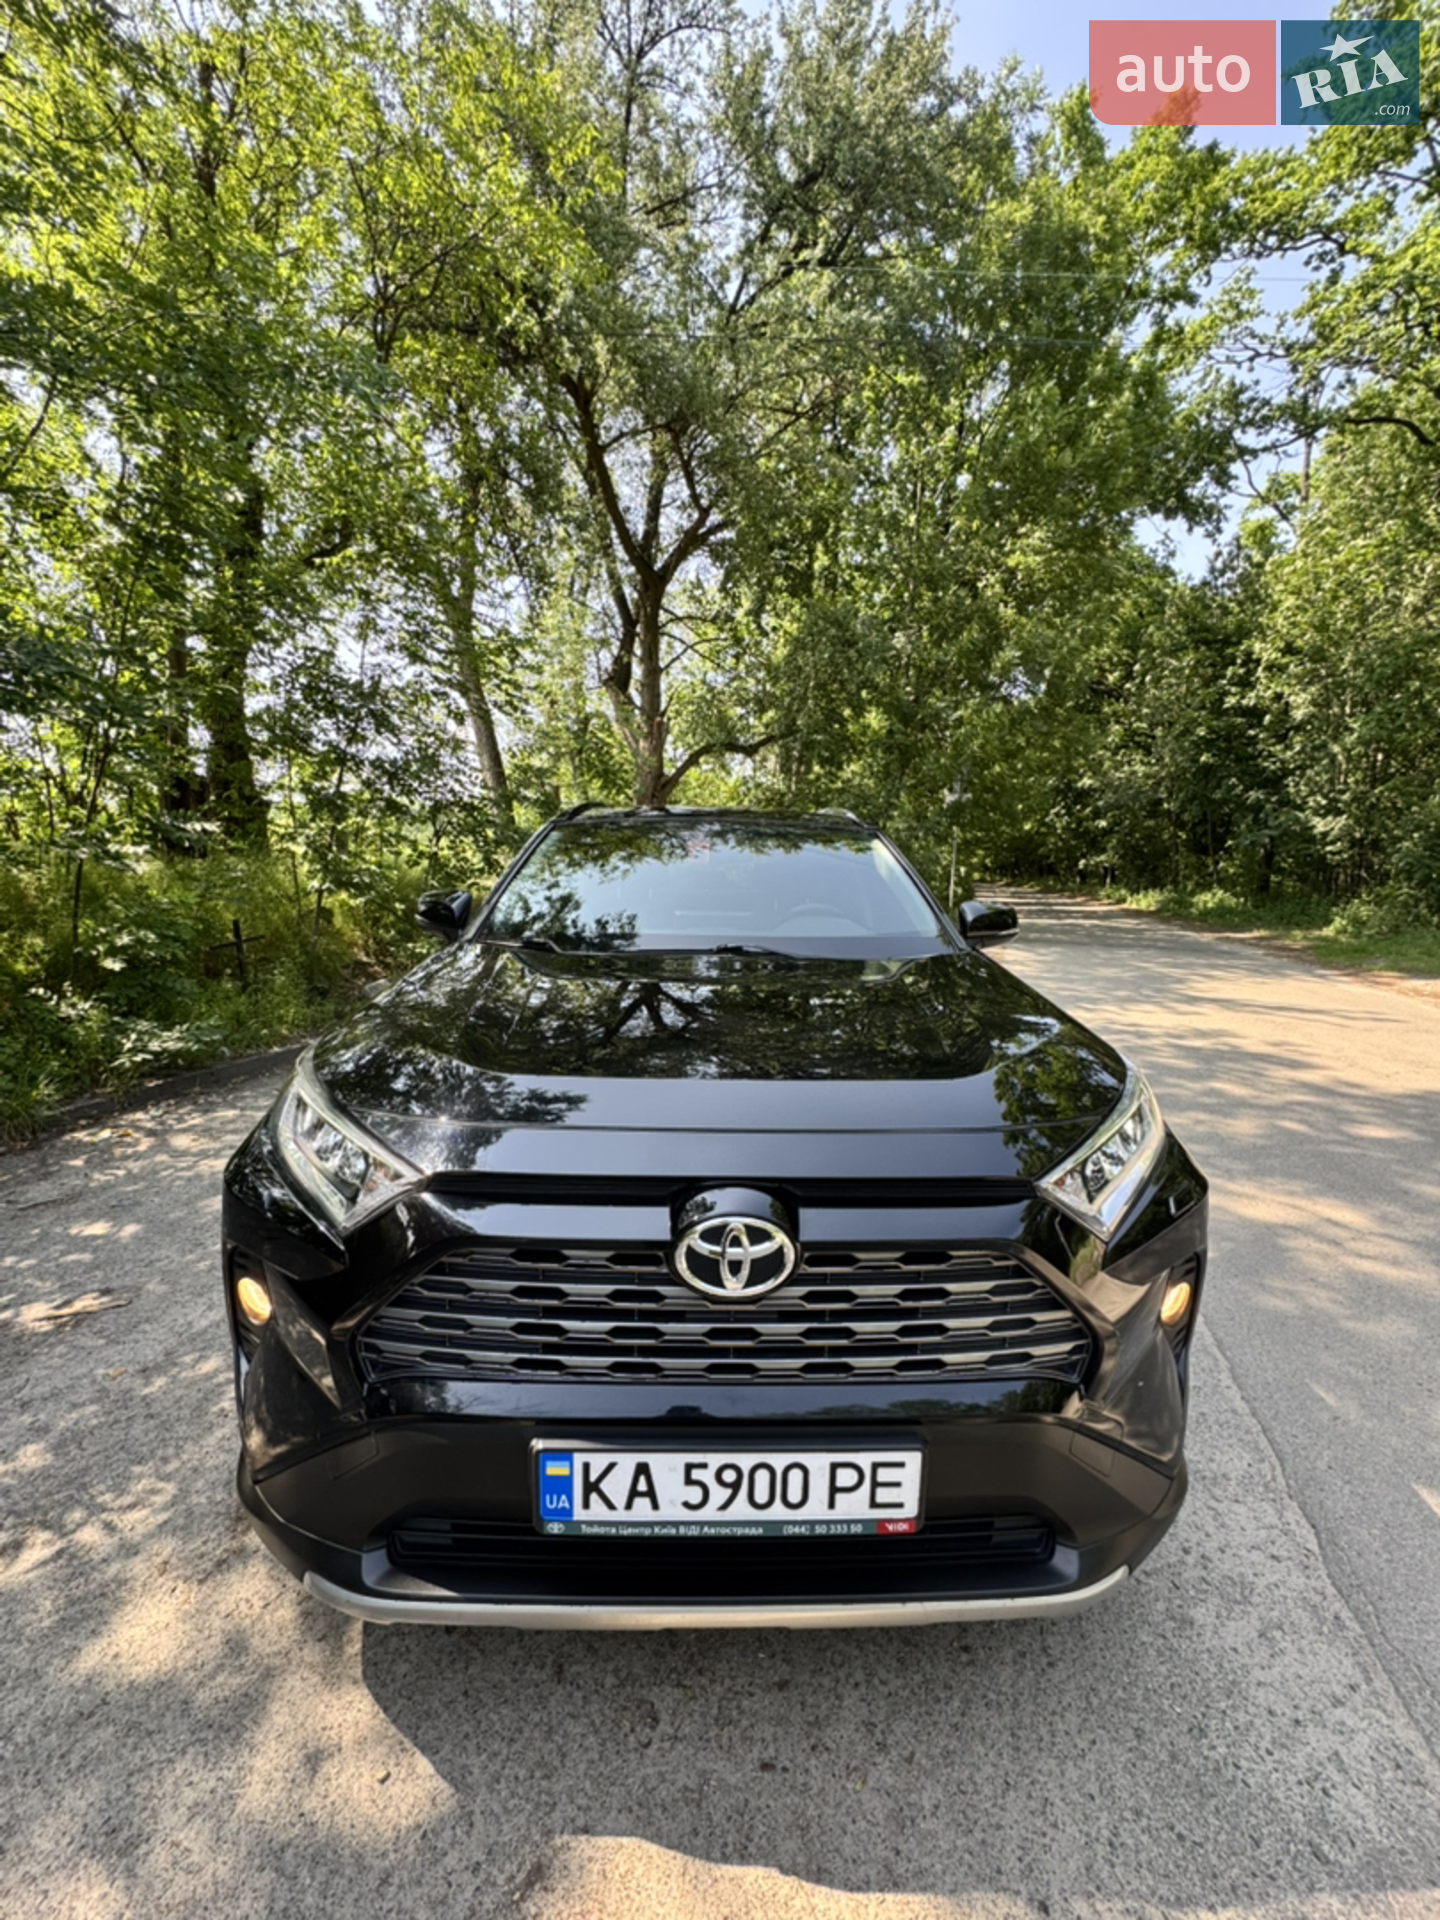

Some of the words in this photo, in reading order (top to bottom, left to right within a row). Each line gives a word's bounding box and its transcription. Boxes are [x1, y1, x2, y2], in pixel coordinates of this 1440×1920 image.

[581, 1461, 660, 1511] KA
[680, 1461, 811, 1511] 5900
[827, 1461, 906, 1510] PE
[545, 1494, 570, 1509] UA
[580, 1524, 616, 1534] Тойота
[618, 1525, 652, 1535] Центр
